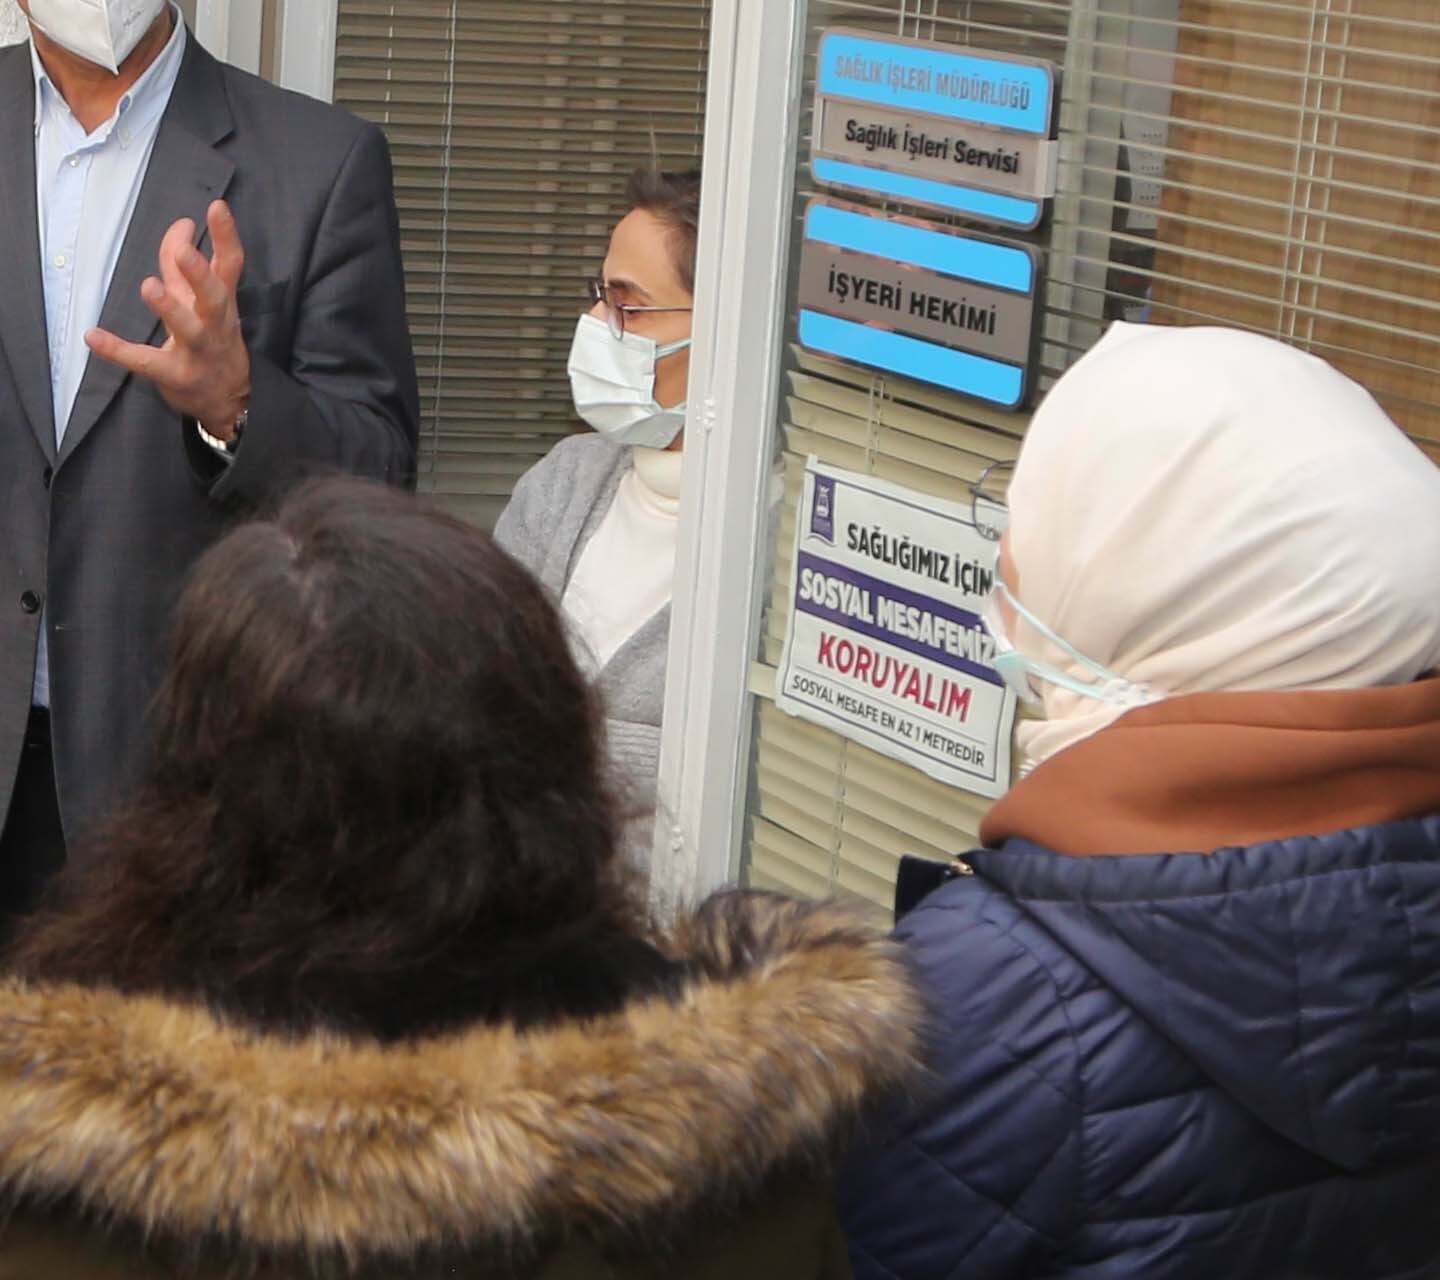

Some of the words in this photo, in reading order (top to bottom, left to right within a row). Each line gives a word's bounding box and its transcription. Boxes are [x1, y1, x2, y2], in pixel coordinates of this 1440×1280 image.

[834, 53, 883, 84] SAĞLIK
[886, 59, 932, 95] İŞLERİ
[935, 67, 1032, 111] MÜDÜRLÜĞÜ
[844, 118, 898, 152] Sağlık
[902, 123, 949, 162] İşleri
[954, 141, 1020, 176] Servisi
[827, 263, 902, 312] İŞYERİ
[909, 289, 997, 337] HEKİMİ
[847, 522, 950, 585] SAĞLIĞIMIZ
[954, 553, 995, 598] İÇİN
[799, 567, 875, 626] SOSYAL
[877, 595, 996, 666] MESAFEMİZ
[817, 630, 973, 723] KORUYALIM
[792, 674, 834, 706] SOSYAL
[836, 691, 880, 723] MESAFE
[881, 708, 896, 730] EN
[897, 716, 912, 737] AZ
[923, 726, 986, 768] METREDİR
